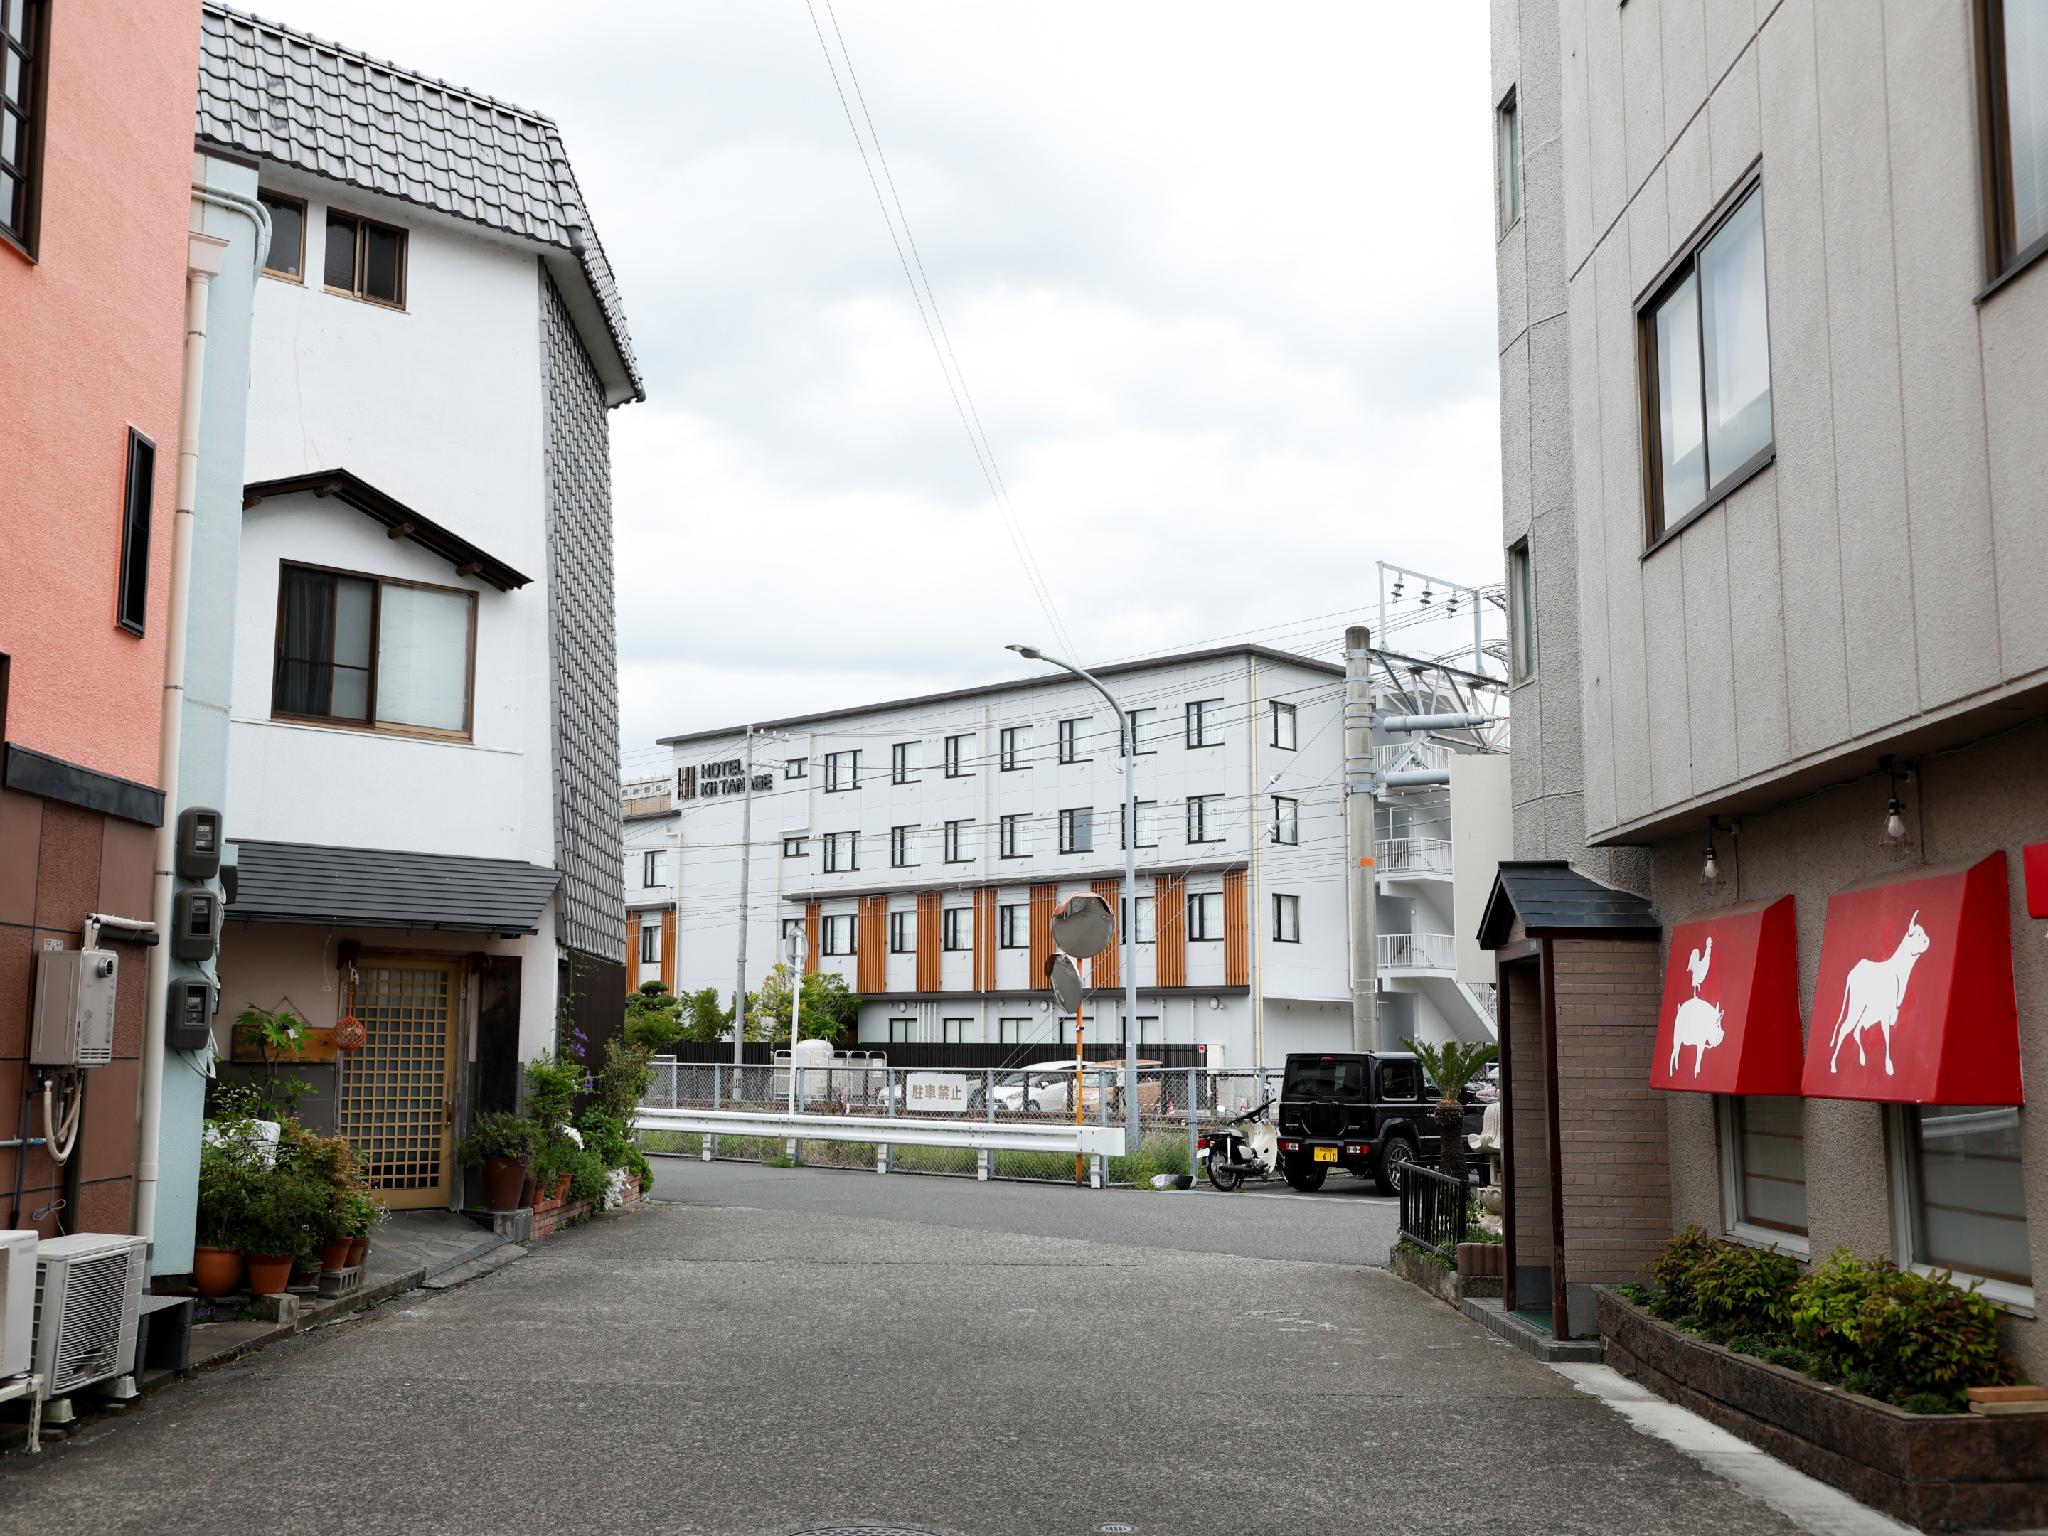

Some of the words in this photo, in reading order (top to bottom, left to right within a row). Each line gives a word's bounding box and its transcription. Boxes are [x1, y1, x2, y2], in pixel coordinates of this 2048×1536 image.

[701, 759, 745, 779] HOTEL
[912, 1084, 961, 1100] 駐車禁止
